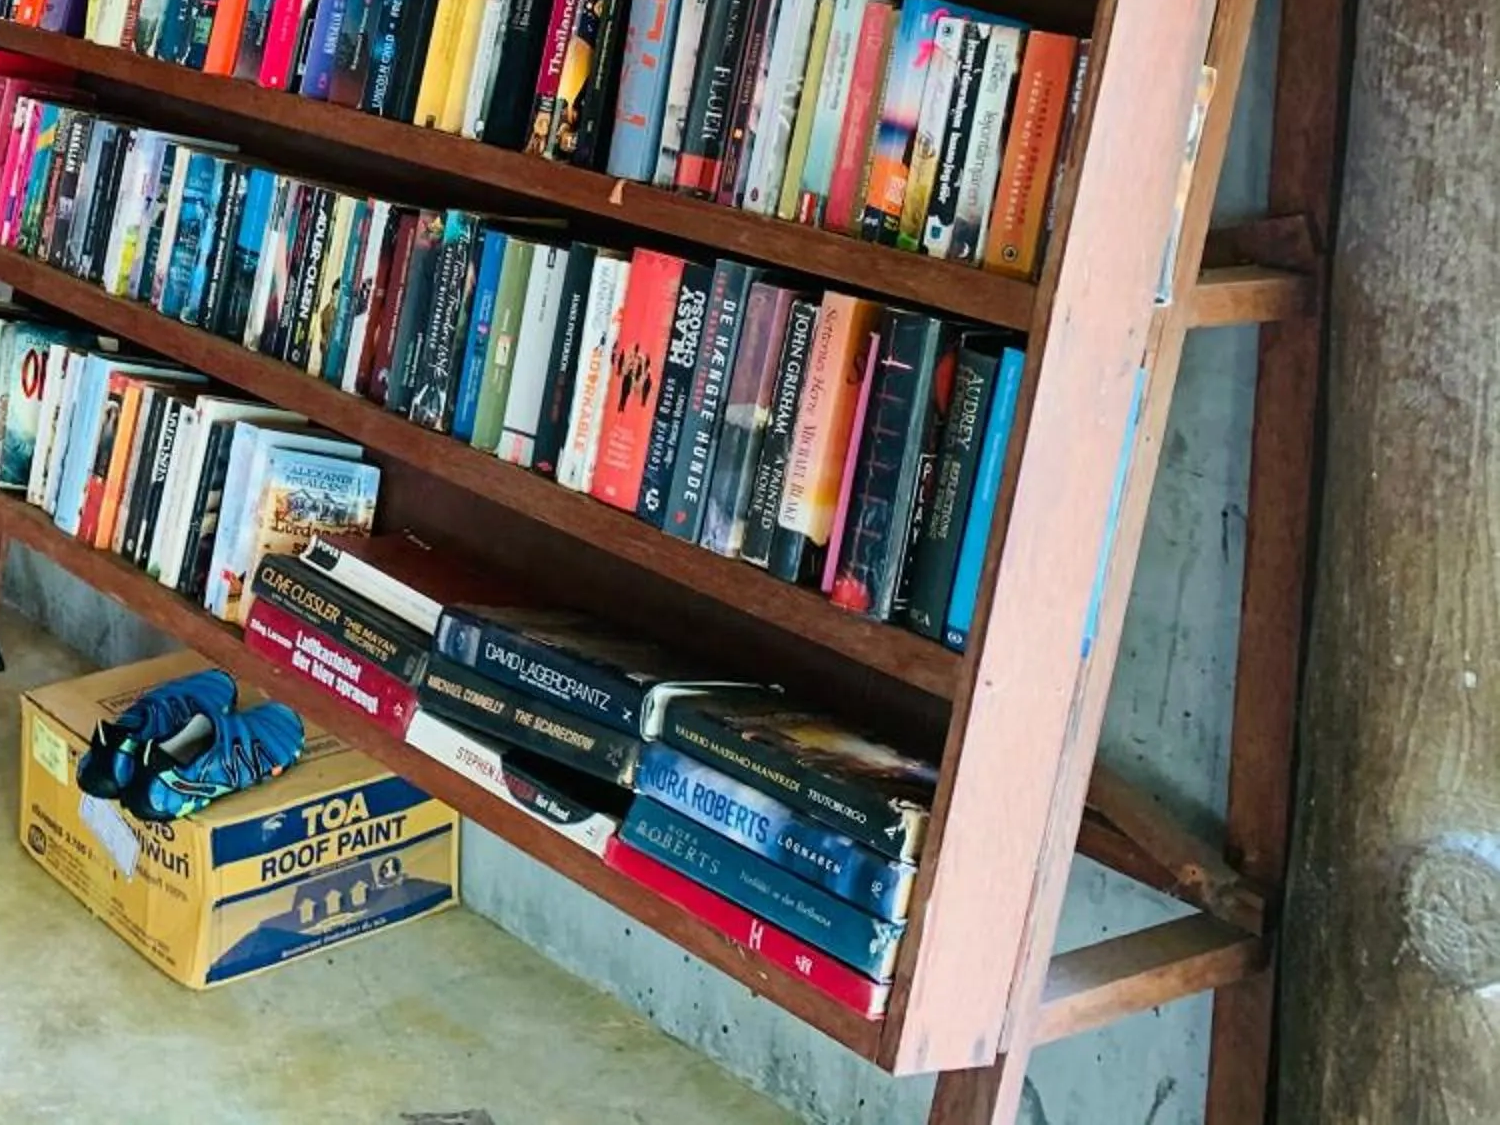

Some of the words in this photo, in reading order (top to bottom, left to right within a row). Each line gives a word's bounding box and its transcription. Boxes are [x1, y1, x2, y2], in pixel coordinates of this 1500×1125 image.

[300, 209, 328, 320] ADLER-OLSEN
[668, 285, 696, 365] HLASY
[682, 290, 707, 368] CHAOSU
[720, 300, 737, 324] DE
[788, 310, 811, 360] JOHN
[701, 335, 729, 422] HÆNGTE
[771, 360, 797, 435] GRISHAM
[960, 370, 985, 451] AUDREY
[684, 431, 711, 504] HUNDE
[261, 566, 293, 596] CLIVE
[291, 584, 341, 624] CUSSLER
[343, 615, 363, 634] THE
[361, 627, 398, 656] MAYAN
[484, 641, 521, 671] DAVID
[519, 658, 612, 713] LAGERCRANTZ
[426, 674, 463, 701] MICHAEL
[462, 686, 506, 715] CONNELLY
[513, 707, 535, 727] THE
[532, 715, 597, 752] SCARECROW
[455, 745, 497, 780] STEPHEN
[301, 792, 370, 837] TOA
[636, 818, 722, 875] ROBERTS
[691, 780, 771, 845] ROBERTS
[260, 839, 333, 882] ROOF
[336, 815, 408, 860] PAINT
